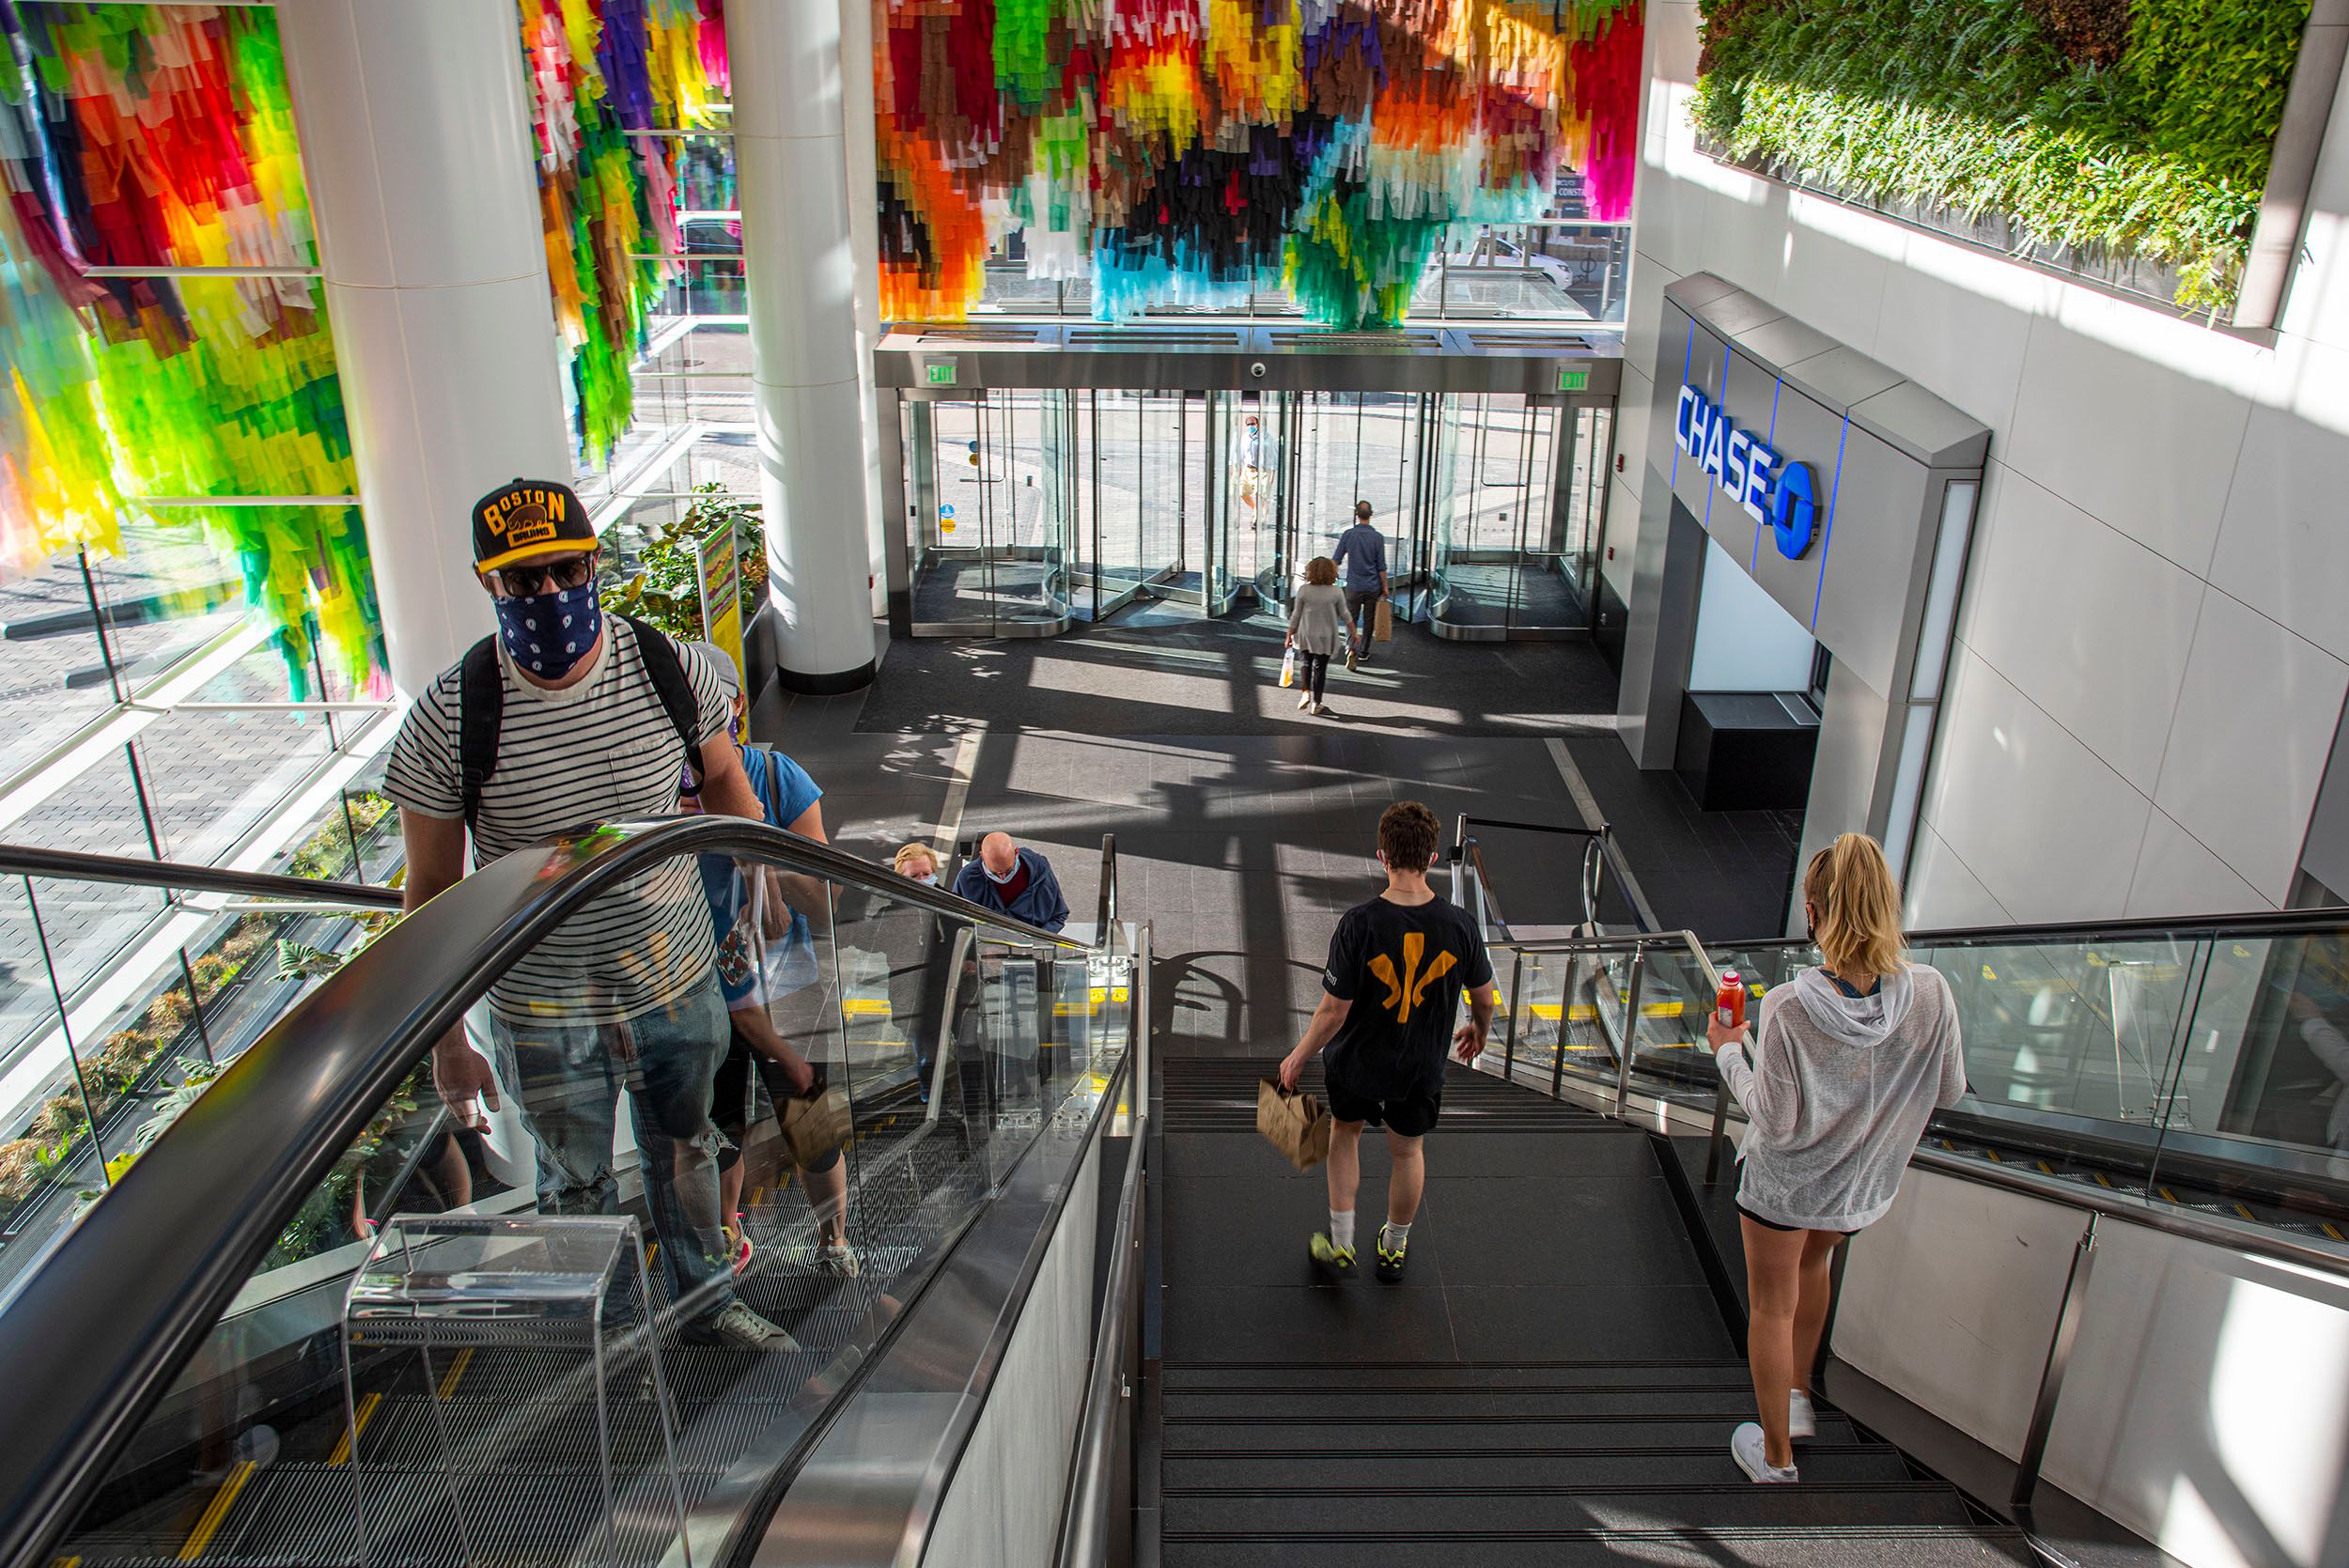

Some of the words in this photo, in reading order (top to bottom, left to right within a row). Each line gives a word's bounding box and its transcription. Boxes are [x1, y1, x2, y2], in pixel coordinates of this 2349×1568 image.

[930, 365, 954, 382] EXIT
[1563, 372, 1587, 388] EXIT
[1675, 384, 1781, 526] CHASE
[483, 489, 565, 537] BOSTON
[512, 526, 551, 542] BRUINS
